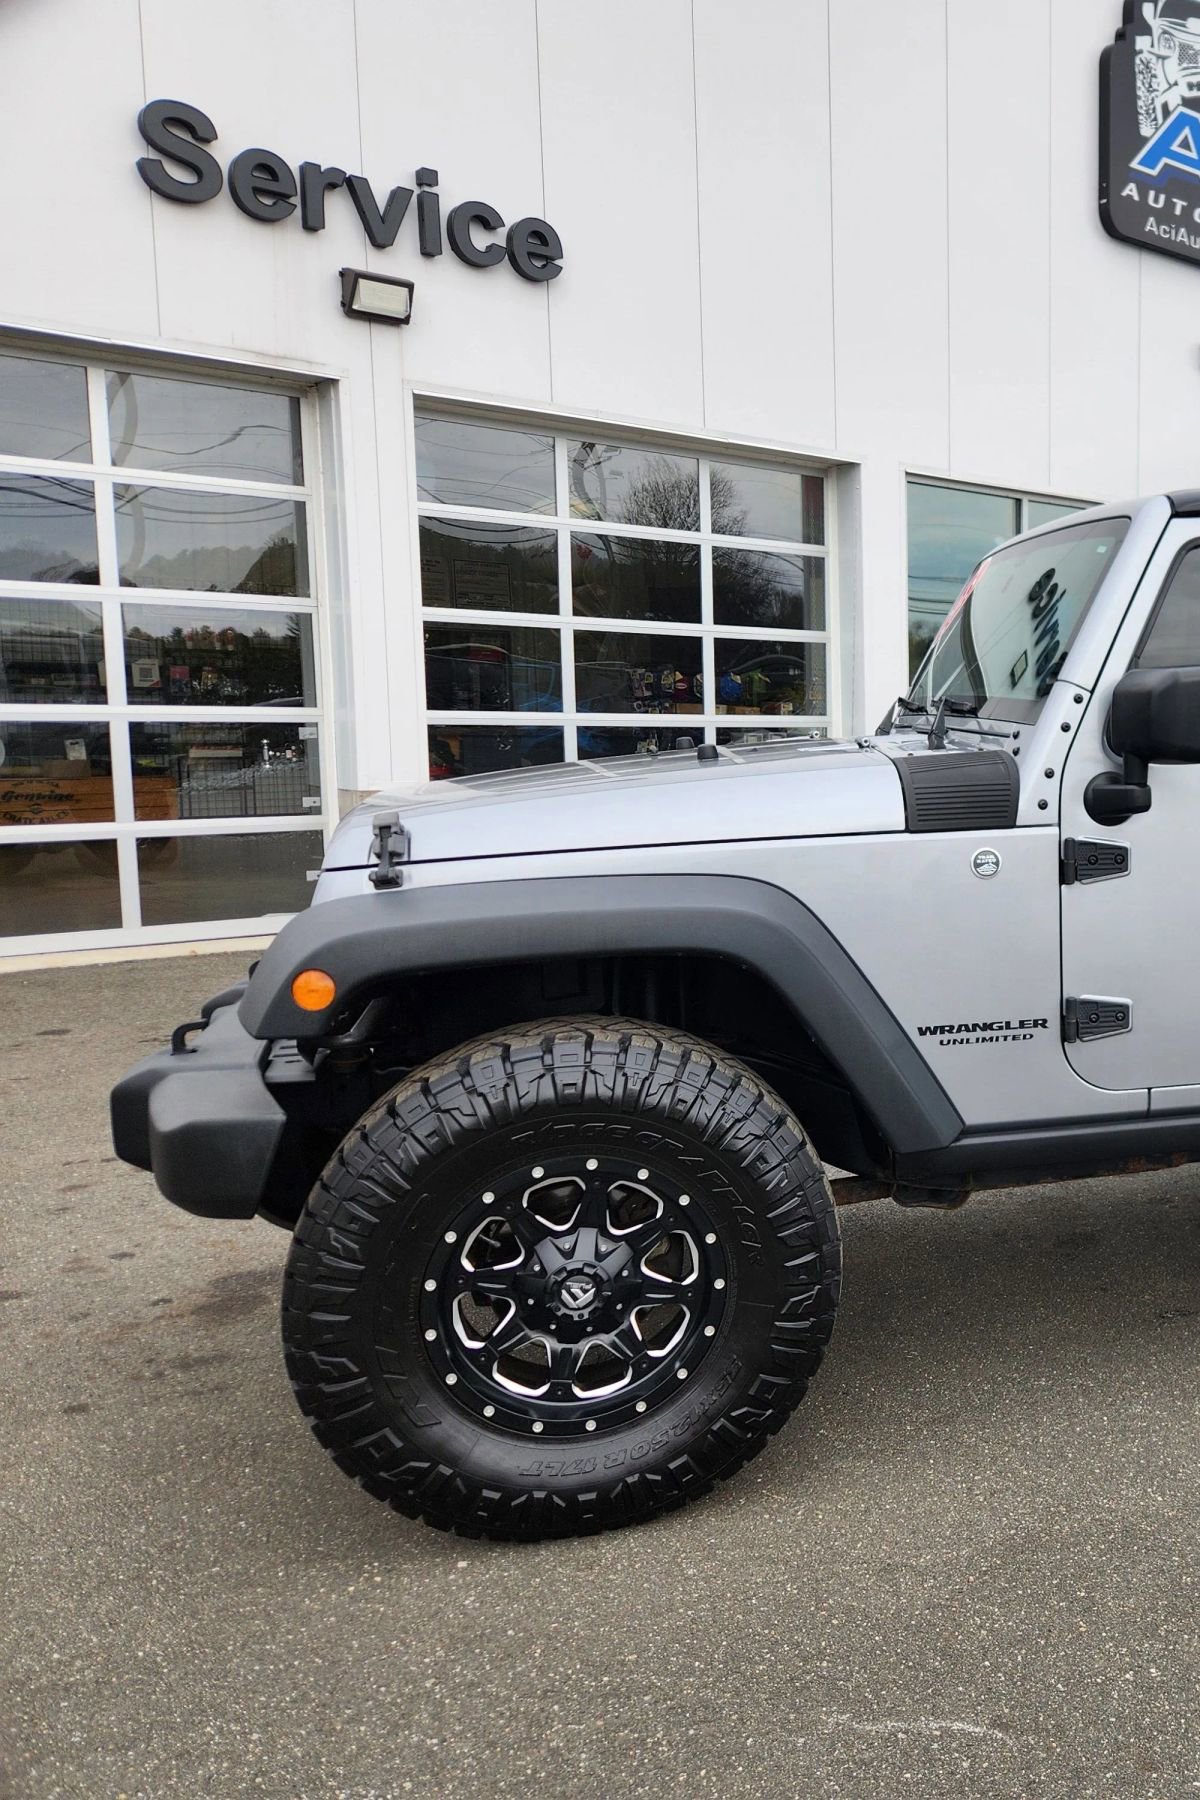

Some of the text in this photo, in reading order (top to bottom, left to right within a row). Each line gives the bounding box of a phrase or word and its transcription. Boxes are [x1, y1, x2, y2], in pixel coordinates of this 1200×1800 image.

[136, 98, 564, 283] Service
[917, 1018, 1049, 1036] WRANGLER
[939, 1033, 1034, 1046] UNLIMITED
